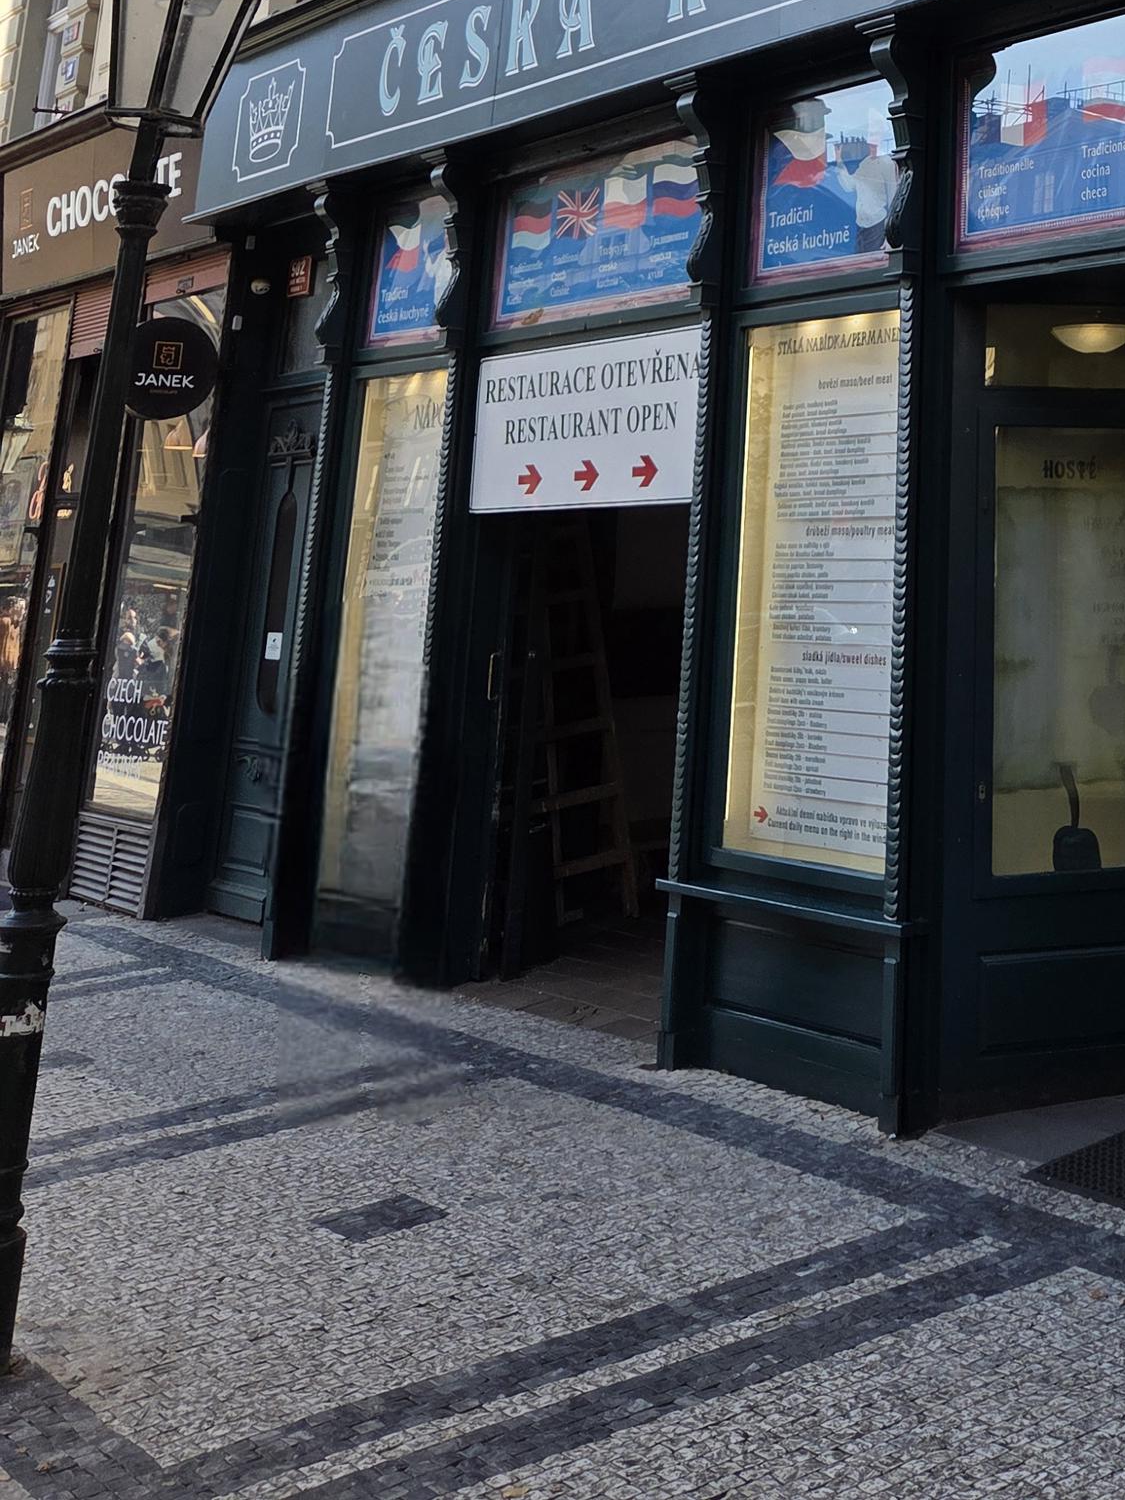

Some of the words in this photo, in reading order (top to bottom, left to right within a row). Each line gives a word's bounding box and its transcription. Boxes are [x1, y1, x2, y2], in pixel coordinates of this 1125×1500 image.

[1080, 163, 1111, 179] cocina
[1080, 184, 1108, 201] checa
[769, 203, 814, 229] Tradiční
[12, 233, 40, 259] JANEK
[767, 233, 799, 256] česká
[802, 225, 850, 251] kuchyně
[134, 372, 195, 389] JANEK
[485, 365, 596, 404] RESTAURACE
[601, 348, 701, 390] OTEVŘENA
[504, 407, 622, 445] RESTAURANT
[626, 401, 679, 433] OPEN
[107, 677, 143, 704] CZECH
[101, 712, 169, 746] CHOCOLATE
